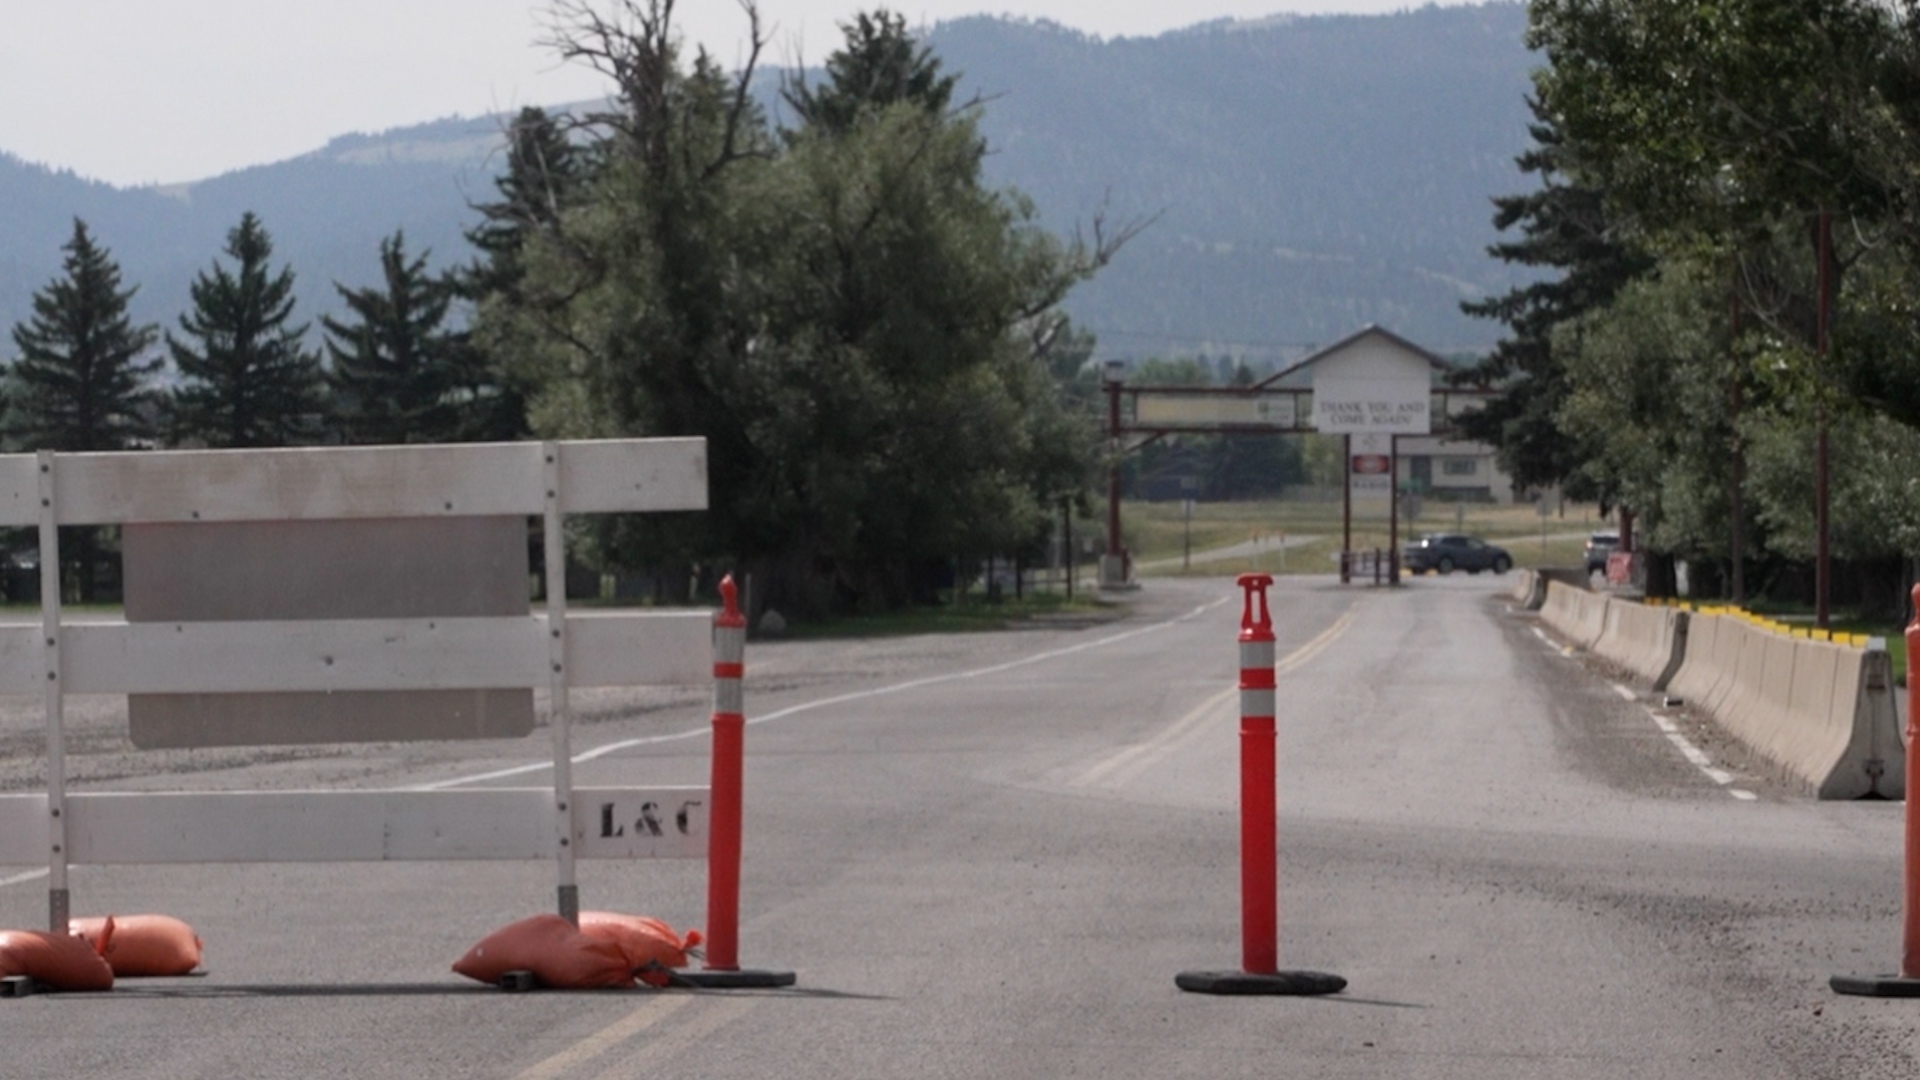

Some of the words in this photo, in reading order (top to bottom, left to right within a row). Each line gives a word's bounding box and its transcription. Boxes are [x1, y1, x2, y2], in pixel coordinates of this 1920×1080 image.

[1320, 401, 1361, 413] THANK
[1367, 401, 1392, 413] YOU
[1398, 401, 1425, 413] AND
[1330, 413, 1363, 425] COME
[600, 802, 623, 838] L
[634, 801, 663, 837] &
